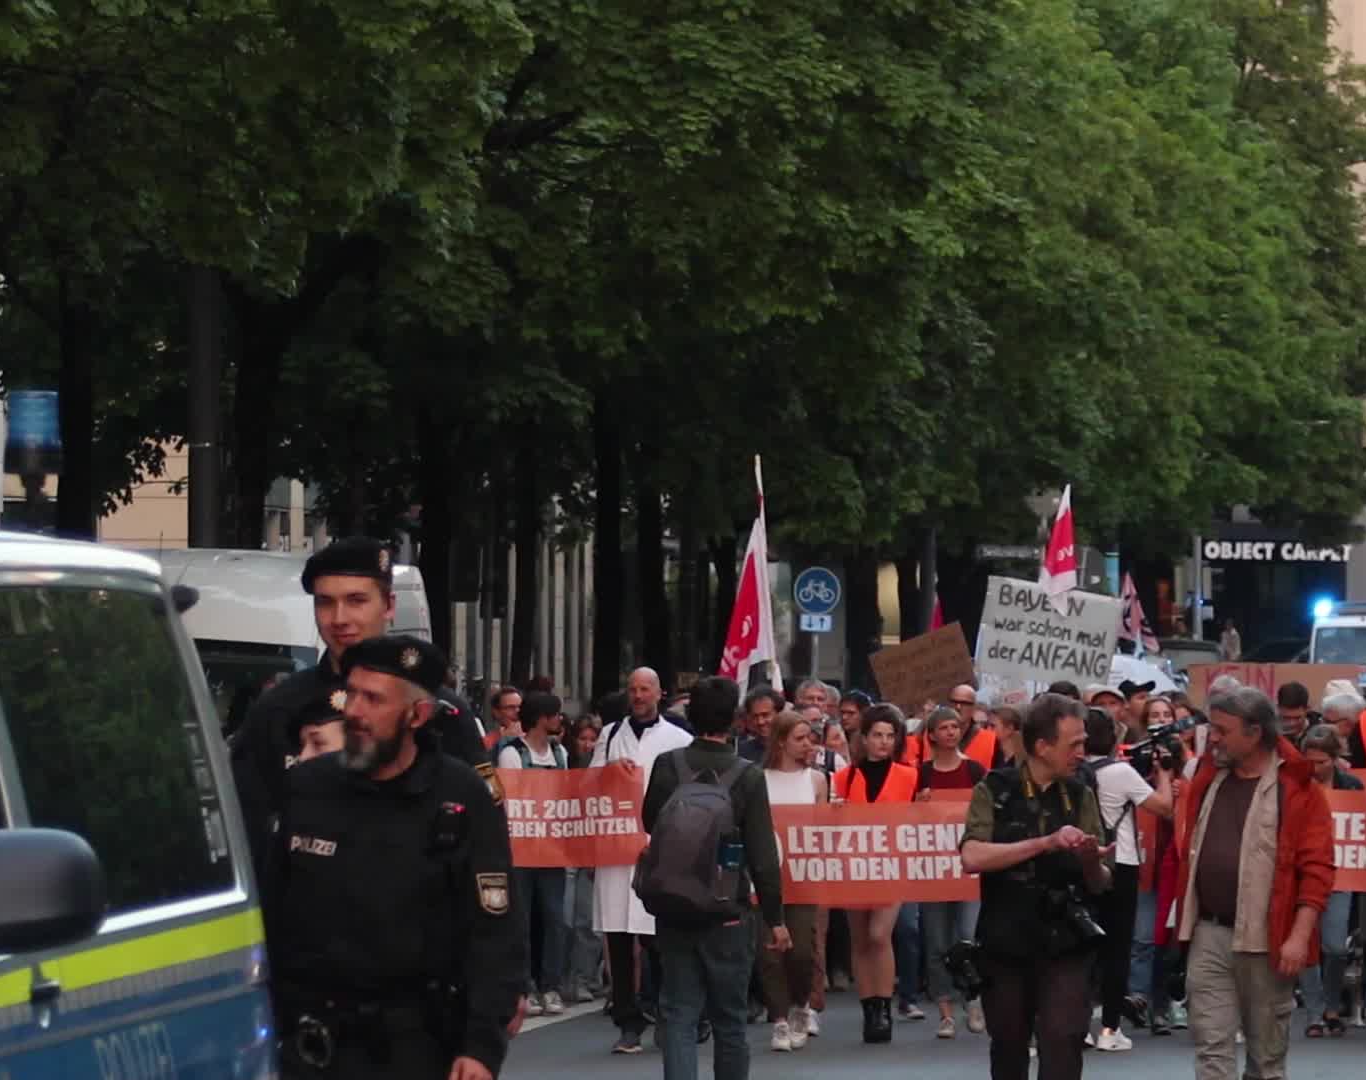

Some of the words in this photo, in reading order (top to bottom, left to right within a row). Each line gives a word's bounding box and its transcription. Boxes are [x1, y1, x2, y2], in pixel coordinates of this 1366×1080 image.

[1204, 541, 1275, 560] OBJECT
[998, 584, 1086, 616] BAYEN
[993, 617, 1023, 630] war
[1026, 619, 1072, 642] schon
[1076, 631, 1108, 649] mal
[988, 640, 1017, 661] der
[1018, 642, 1110, 678] ANFANG
[506, 799, 539, 818] RT.
[543, 799, 581, 818] 20A
[585, 796, 613, 816] GG
[550, 817, 639, 838] SCHÜTZEN
[1331, 811, 1366, 840] TE
[290, 836, 338, 857] POLIZEI
[788, 825, 890, 853] LETZTE
[788, 857, 843, 882] VOR
[850, 857, 900, 881] DEN
